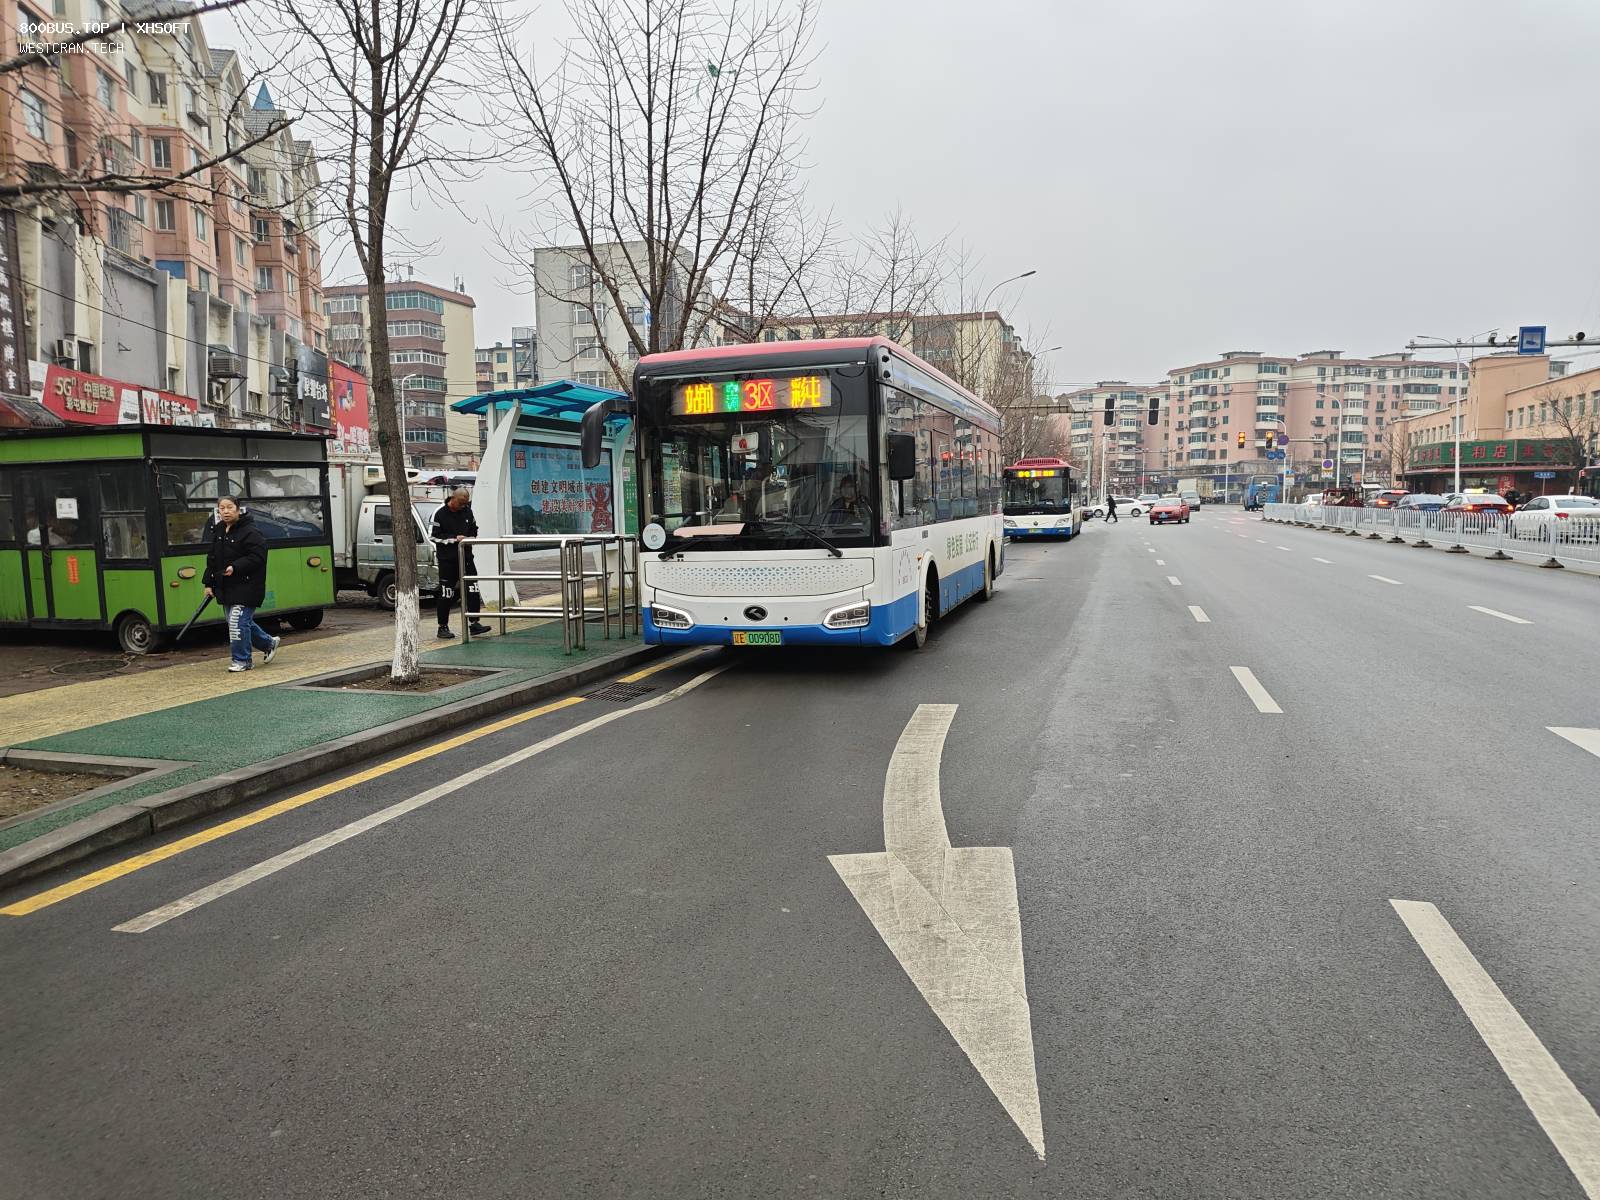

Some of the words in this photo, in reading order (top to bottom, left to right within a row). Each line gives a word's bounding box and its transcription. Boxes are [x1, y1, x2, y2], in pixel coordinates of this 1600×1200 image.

[83, 380, 116, 402] 中国联通
[684, 383, 714, 414] 站前
[744, 381, 773, 410] 3区
[791, 377, 821, 408] 彩屯
[531, 480, 584, 494] 创建文明城市
[542, 498, 593, 513] 建设美好家园
